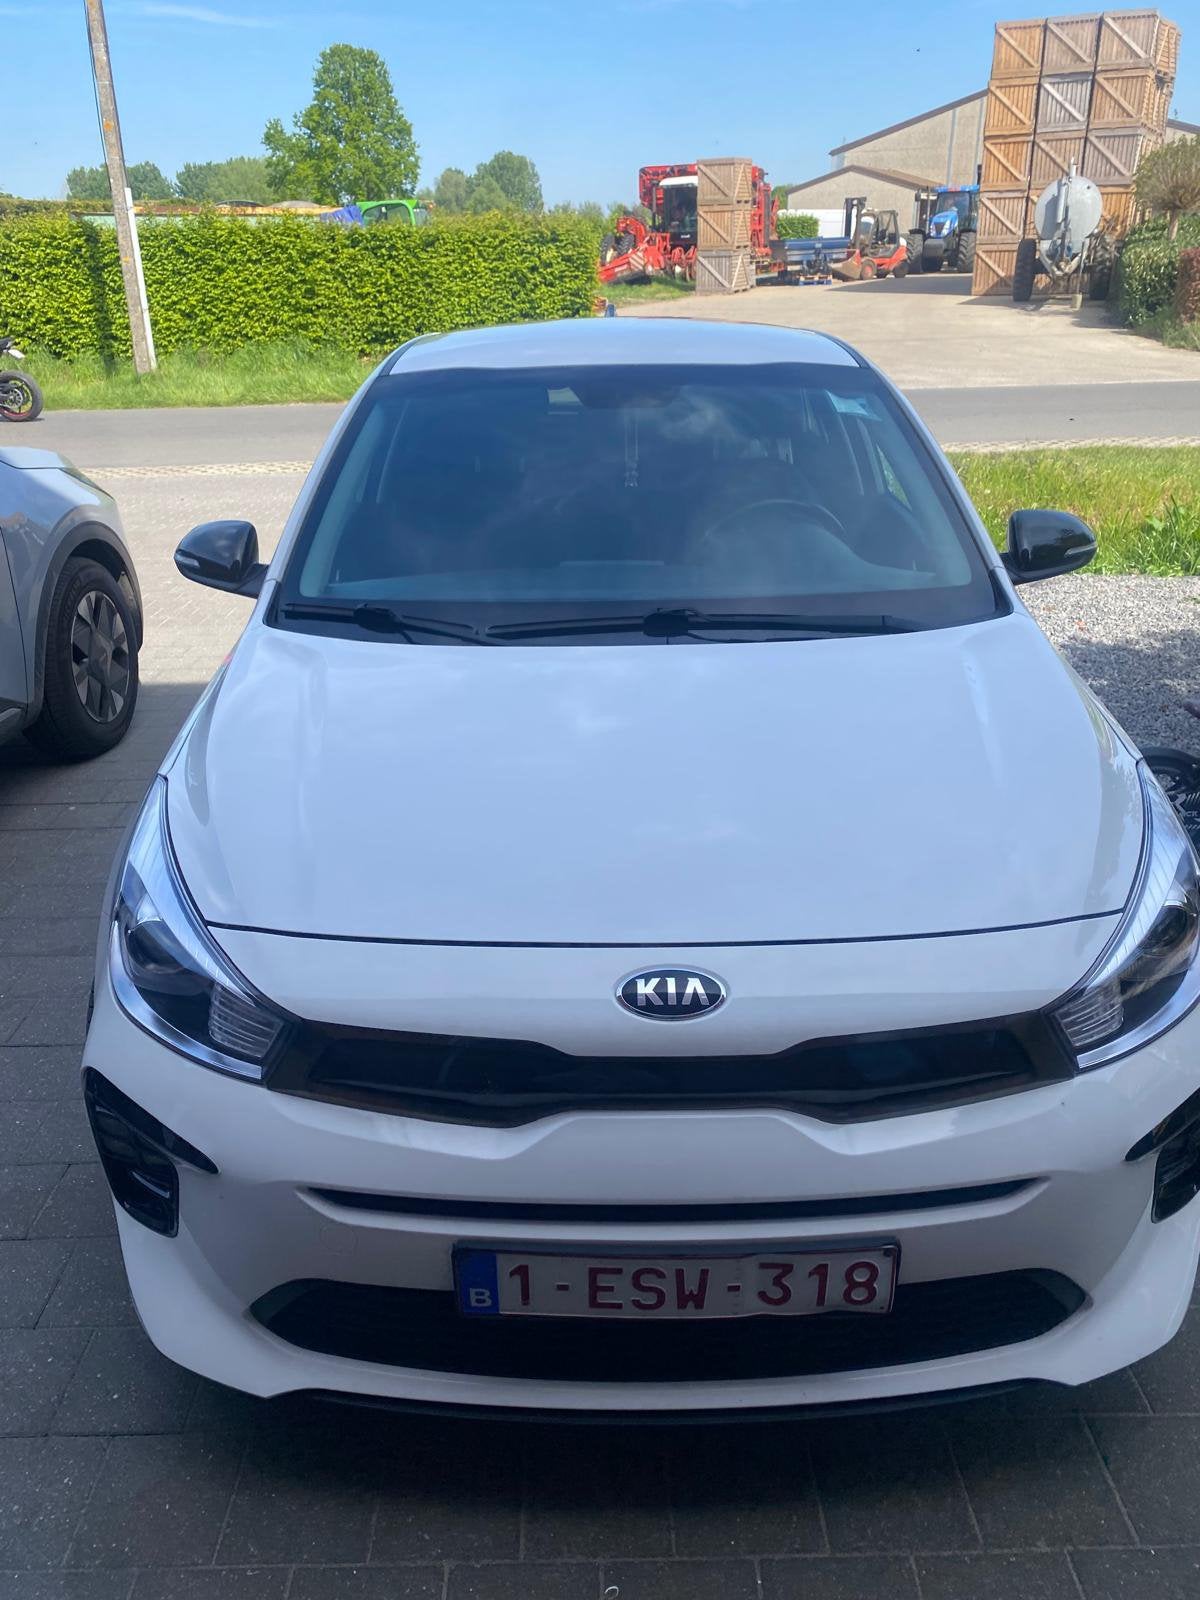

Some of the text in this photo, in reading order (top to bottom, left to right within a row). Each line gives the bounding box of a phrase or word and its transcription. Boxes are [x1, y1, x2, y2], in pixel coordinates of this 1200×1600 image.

[635, 977, 710, 1006] KIA
[469, 1287, 492, 1308] B
[509, 1261, 880, 1311] 1-ESW-318
